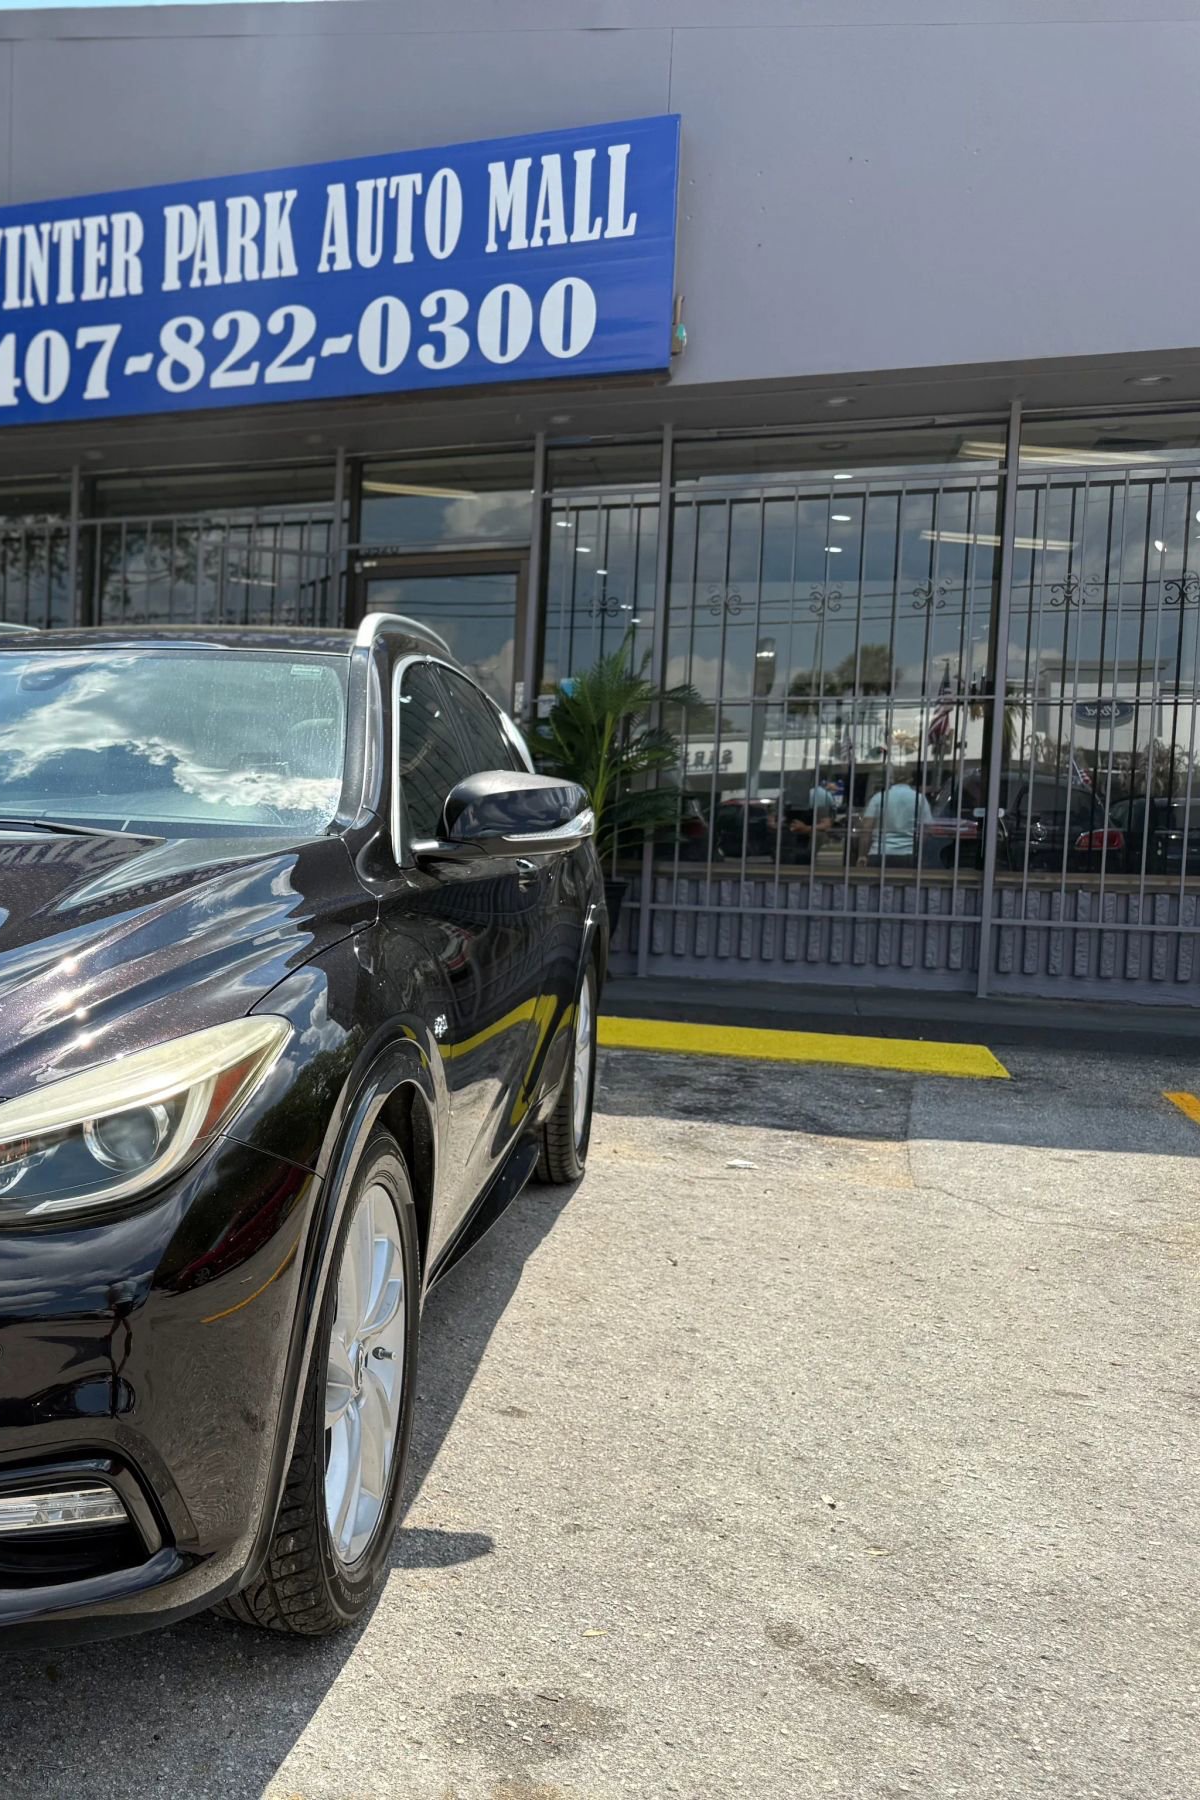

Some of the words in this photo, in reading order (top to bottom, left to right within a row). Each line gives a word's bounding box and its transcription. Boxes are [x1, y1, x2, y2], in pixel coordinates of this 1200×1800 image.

[162, 189, 299, 292] PARK
[317, 167, 463, 273] AUTO
[485, 143, 638, 254] MALL
